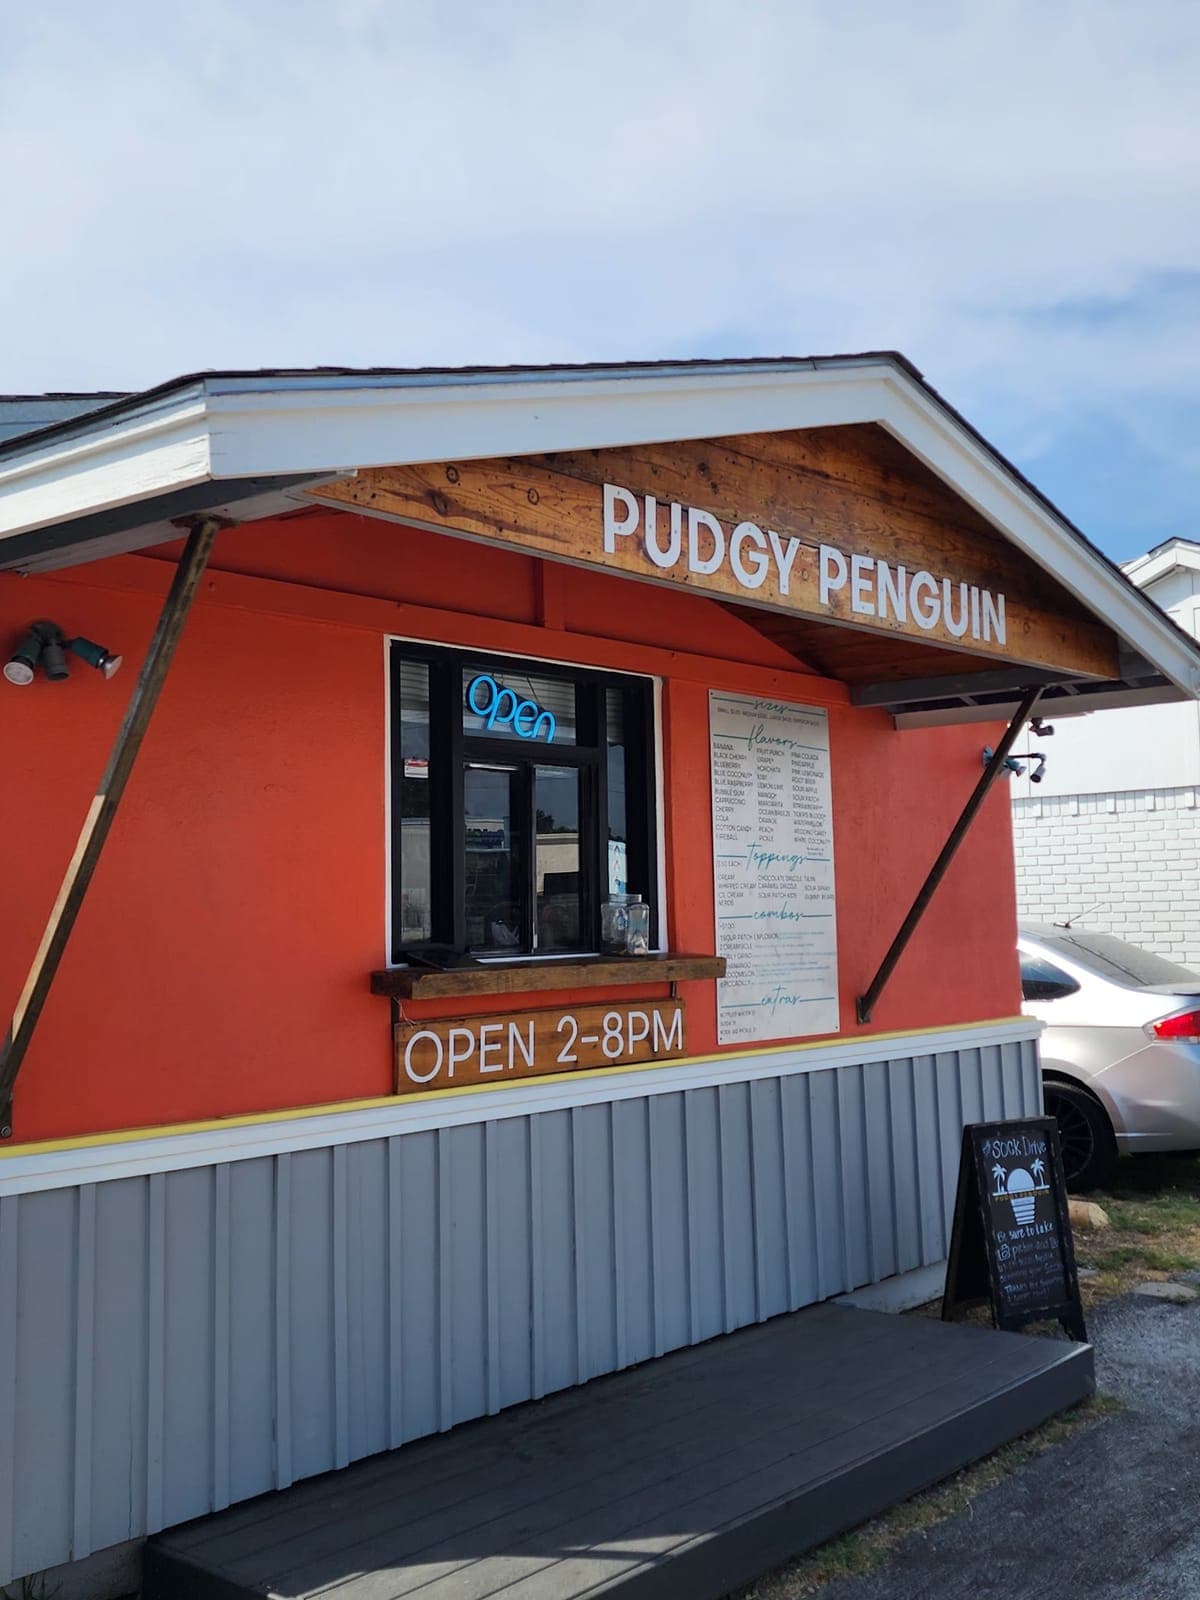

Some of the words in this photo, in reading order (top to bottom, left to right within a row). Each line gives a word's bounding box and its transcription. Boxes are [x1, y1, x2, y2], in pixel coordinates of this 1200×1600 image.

[603, 483, 800, 596] PUDGY
[819, 543, 1007, 646] PENGUIN
[748, 724, 797, 751] flavors
[746, 841, 807, 872] toppings
[753, 901, 804, 922] combos
[761, 983, 800, 1016] extras
[404, 1020, 536, 1084] OPEN
[556, 1007, 684, 1066] 2-8PM
